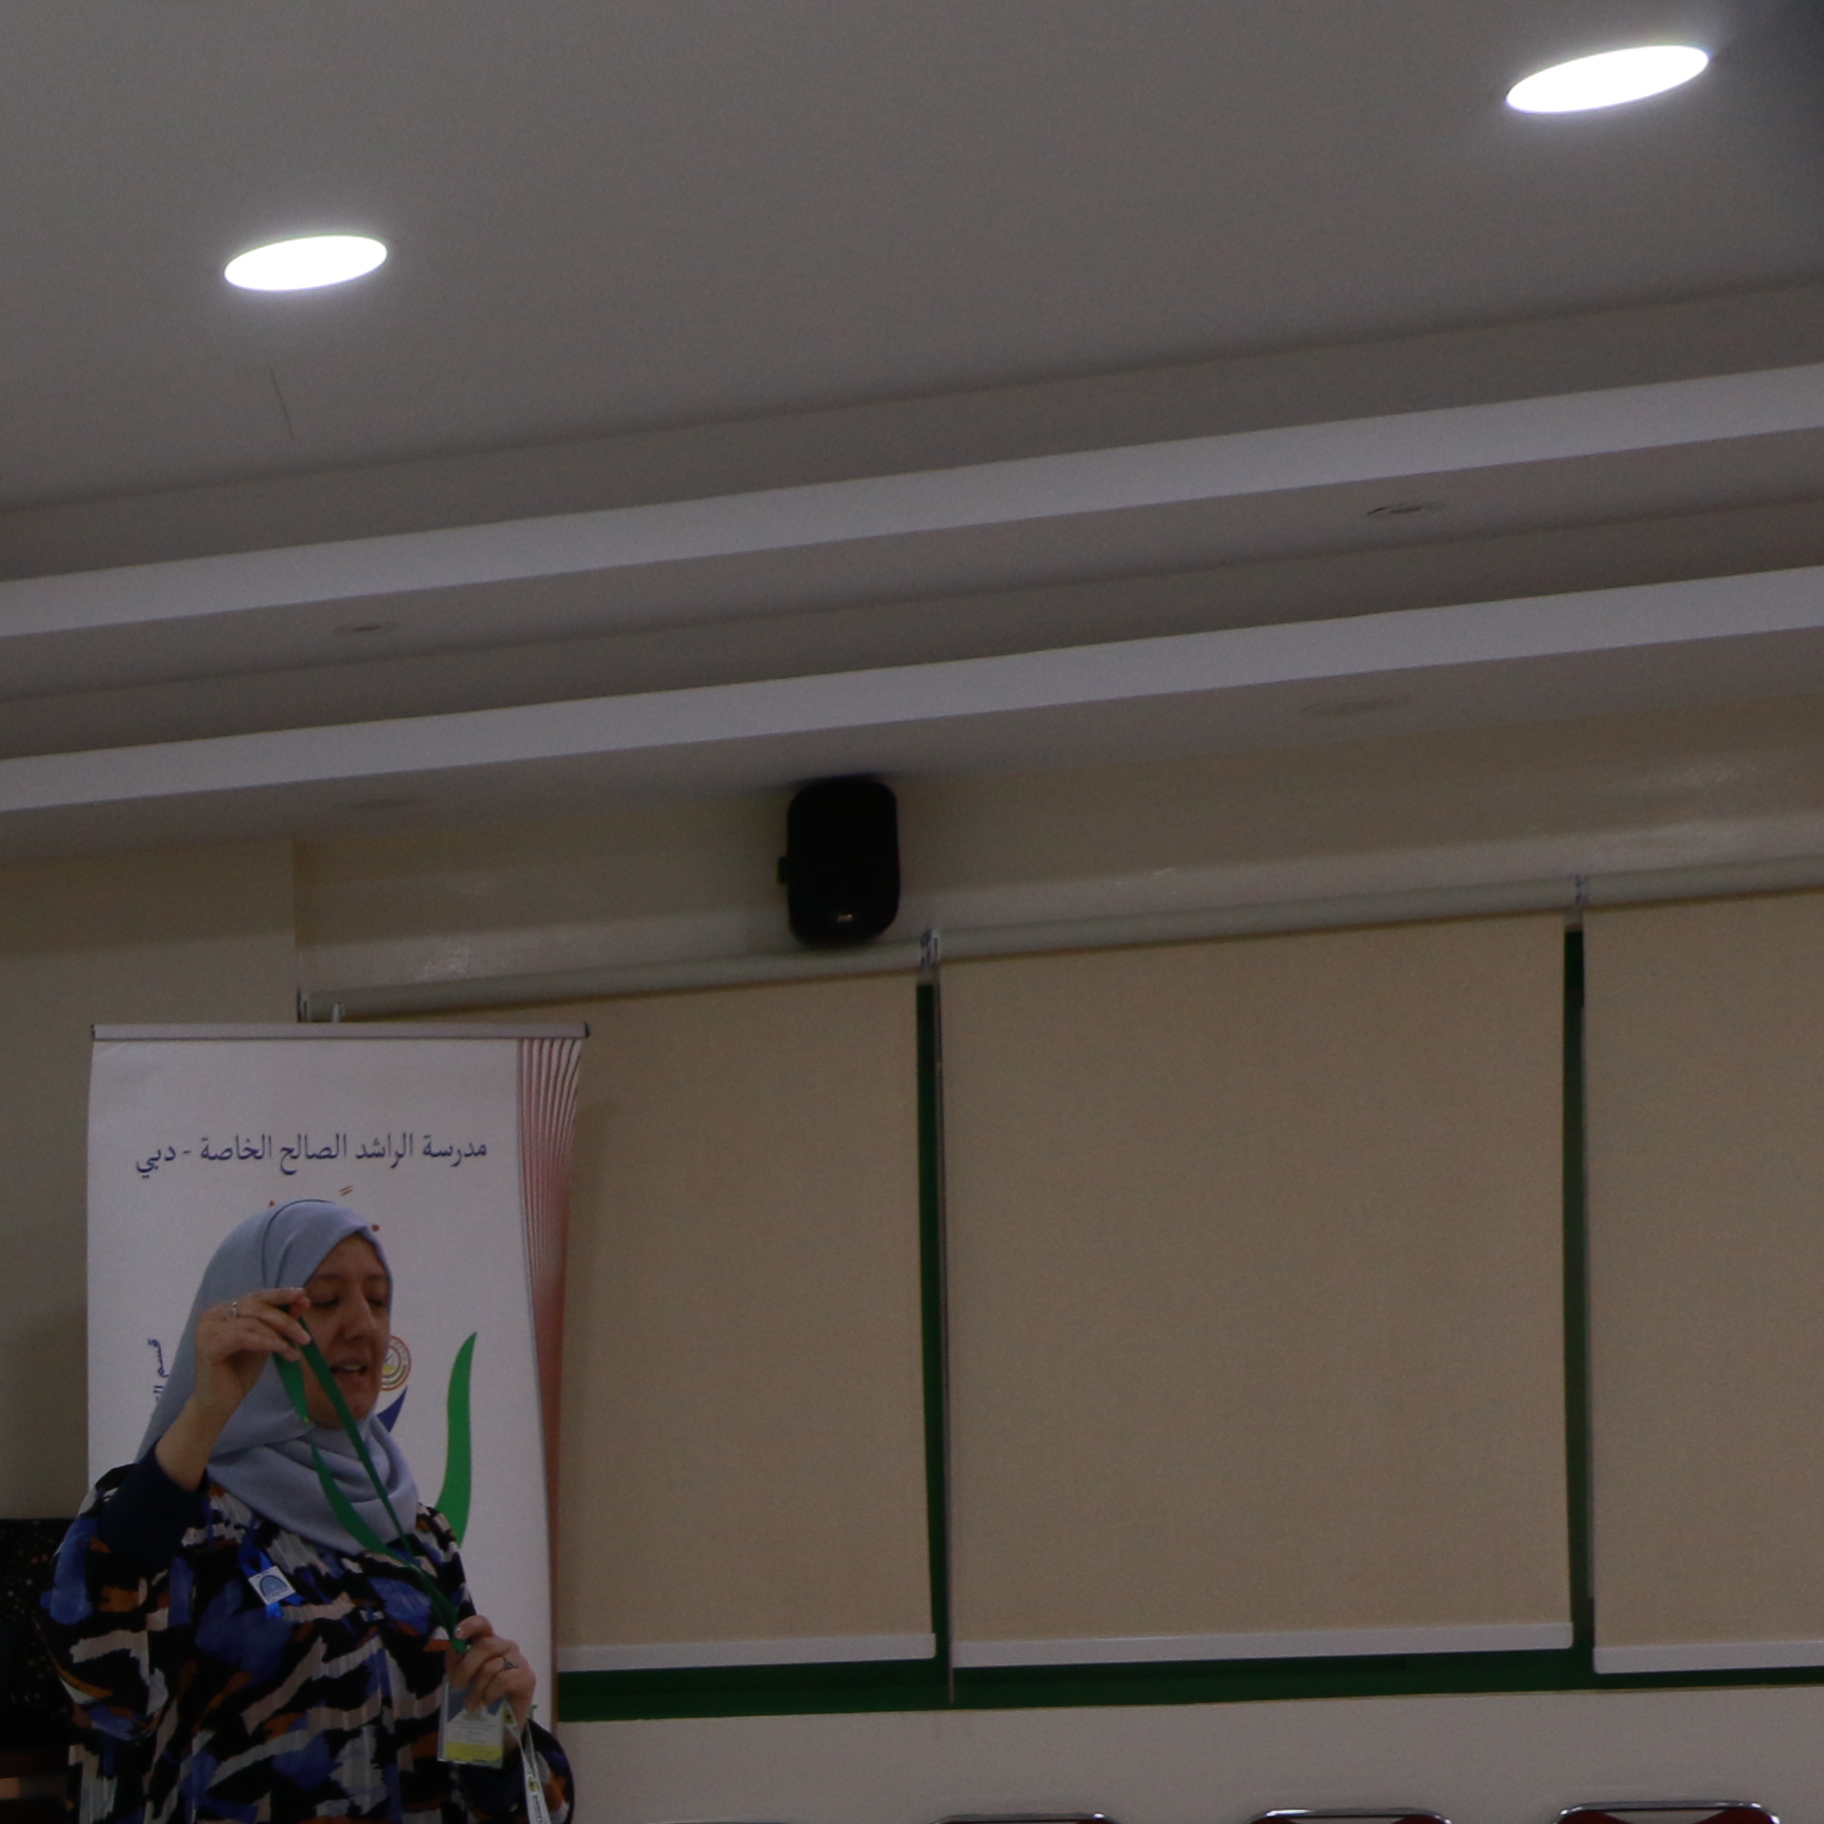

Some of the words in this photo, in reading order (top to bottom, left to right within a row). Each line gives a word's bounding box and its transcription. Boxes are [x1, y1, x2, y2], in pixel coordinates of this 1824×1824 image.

[136, 1144, 177, 1179] دبي
[200, 1134, 272, 1161] الخاصة
[279, 1133, 347, 1175] الصالح
[355, 1132, 413, 1169] الراشد
[422, 1134, 487, 1167] مدرسة
